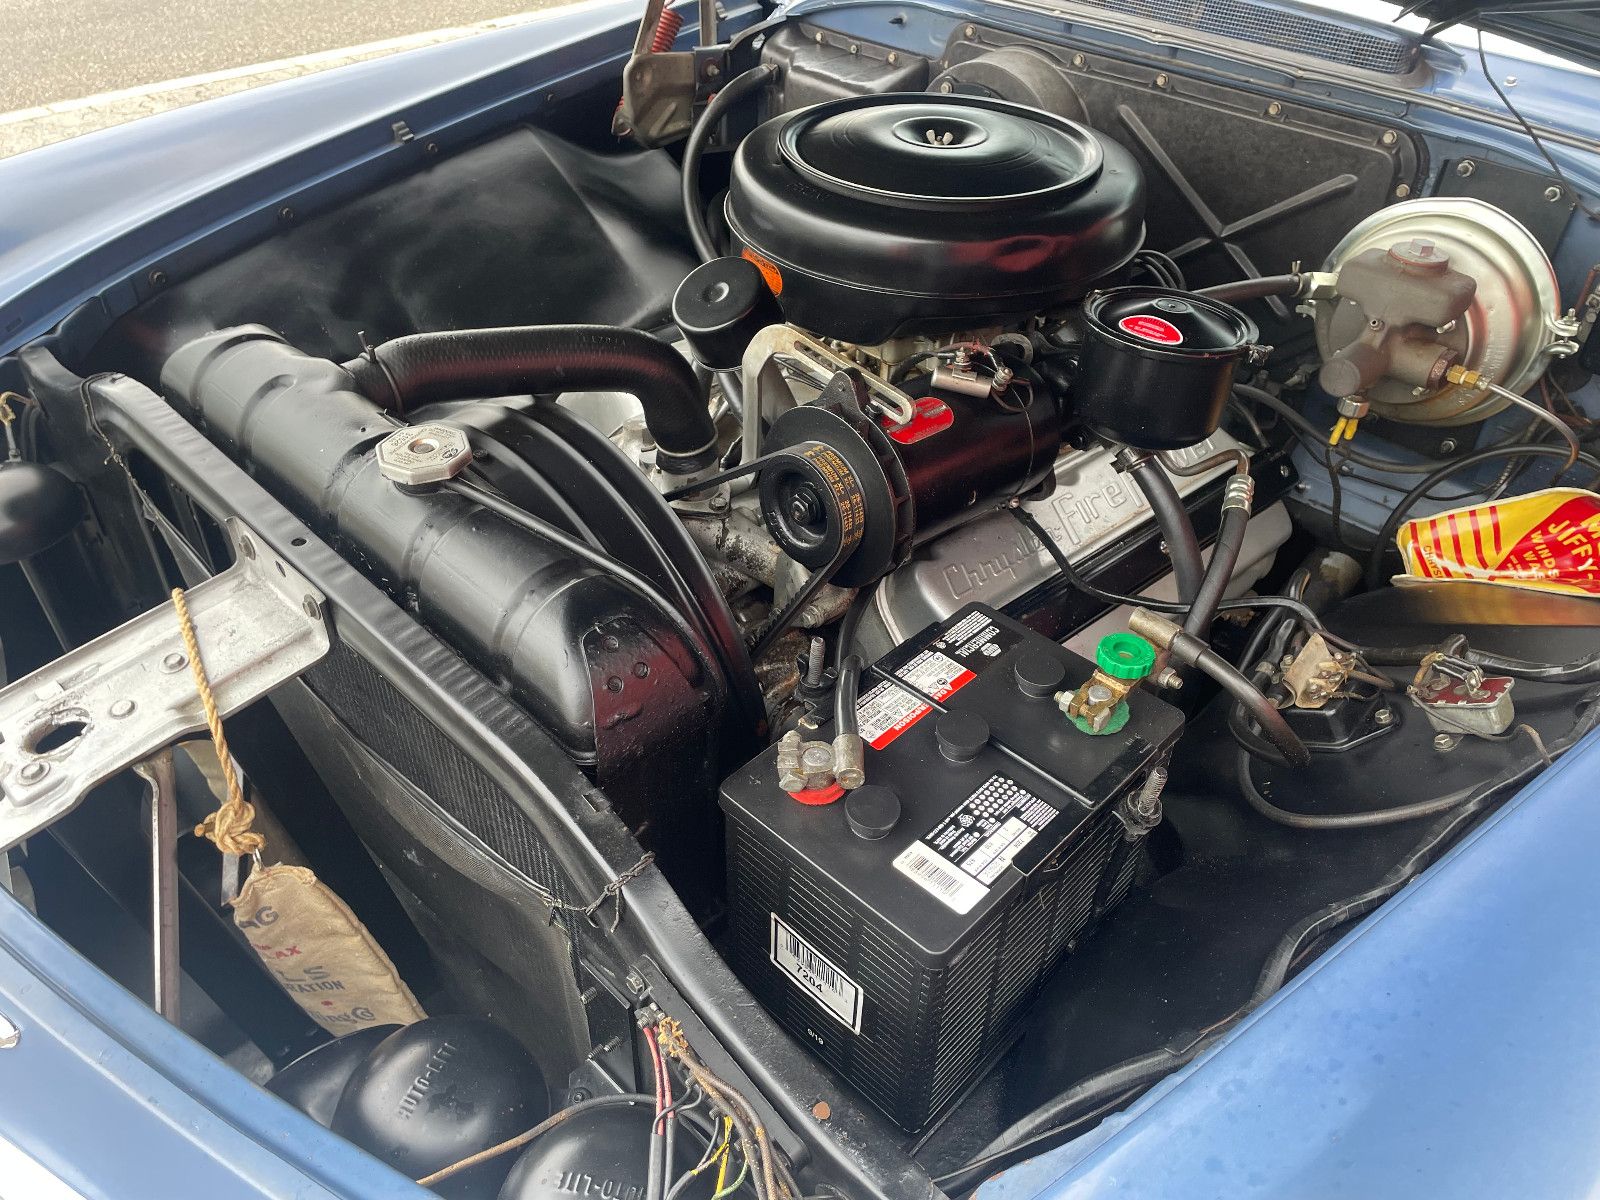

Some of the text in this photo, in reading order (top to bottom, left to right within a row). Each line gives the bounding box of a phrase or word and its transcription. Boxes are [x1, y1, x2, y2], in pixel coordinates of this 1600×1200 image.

[1423, 545, 1443, 578] CHRYS
[954, 625, 1000, 658] COMMERCIAL
[795, 963, 824, 993] 7204
